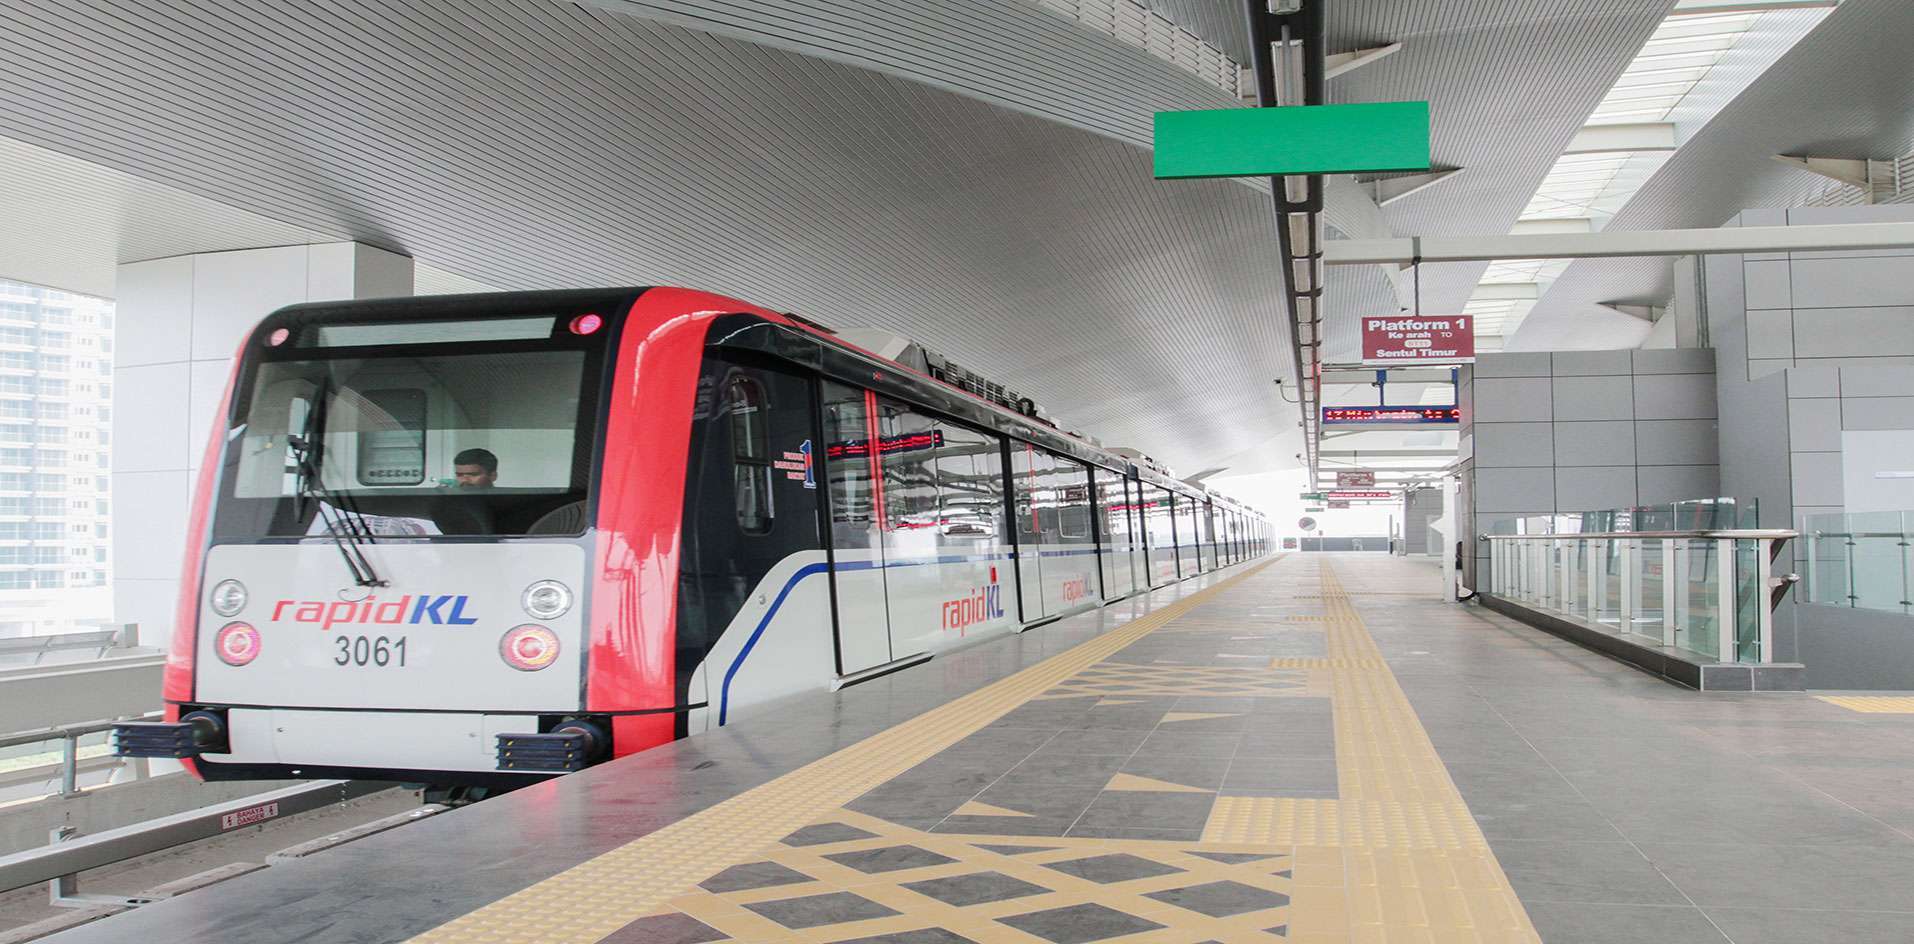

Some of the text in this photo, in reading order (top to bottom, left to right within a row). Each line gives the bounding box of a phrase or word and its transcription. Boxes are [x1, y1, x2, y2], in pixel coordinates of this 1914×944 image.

[1368, 318, 1465, 331] Platform 1
[1406, 331, 1431, 339] arah
[1376, 348, 1457, 357] Sentul Timur
[271, 595, 479, 630] rapidKL
[942, 584, 1005, 637] rapidKL
[334, 635, 408, 667] 3061
